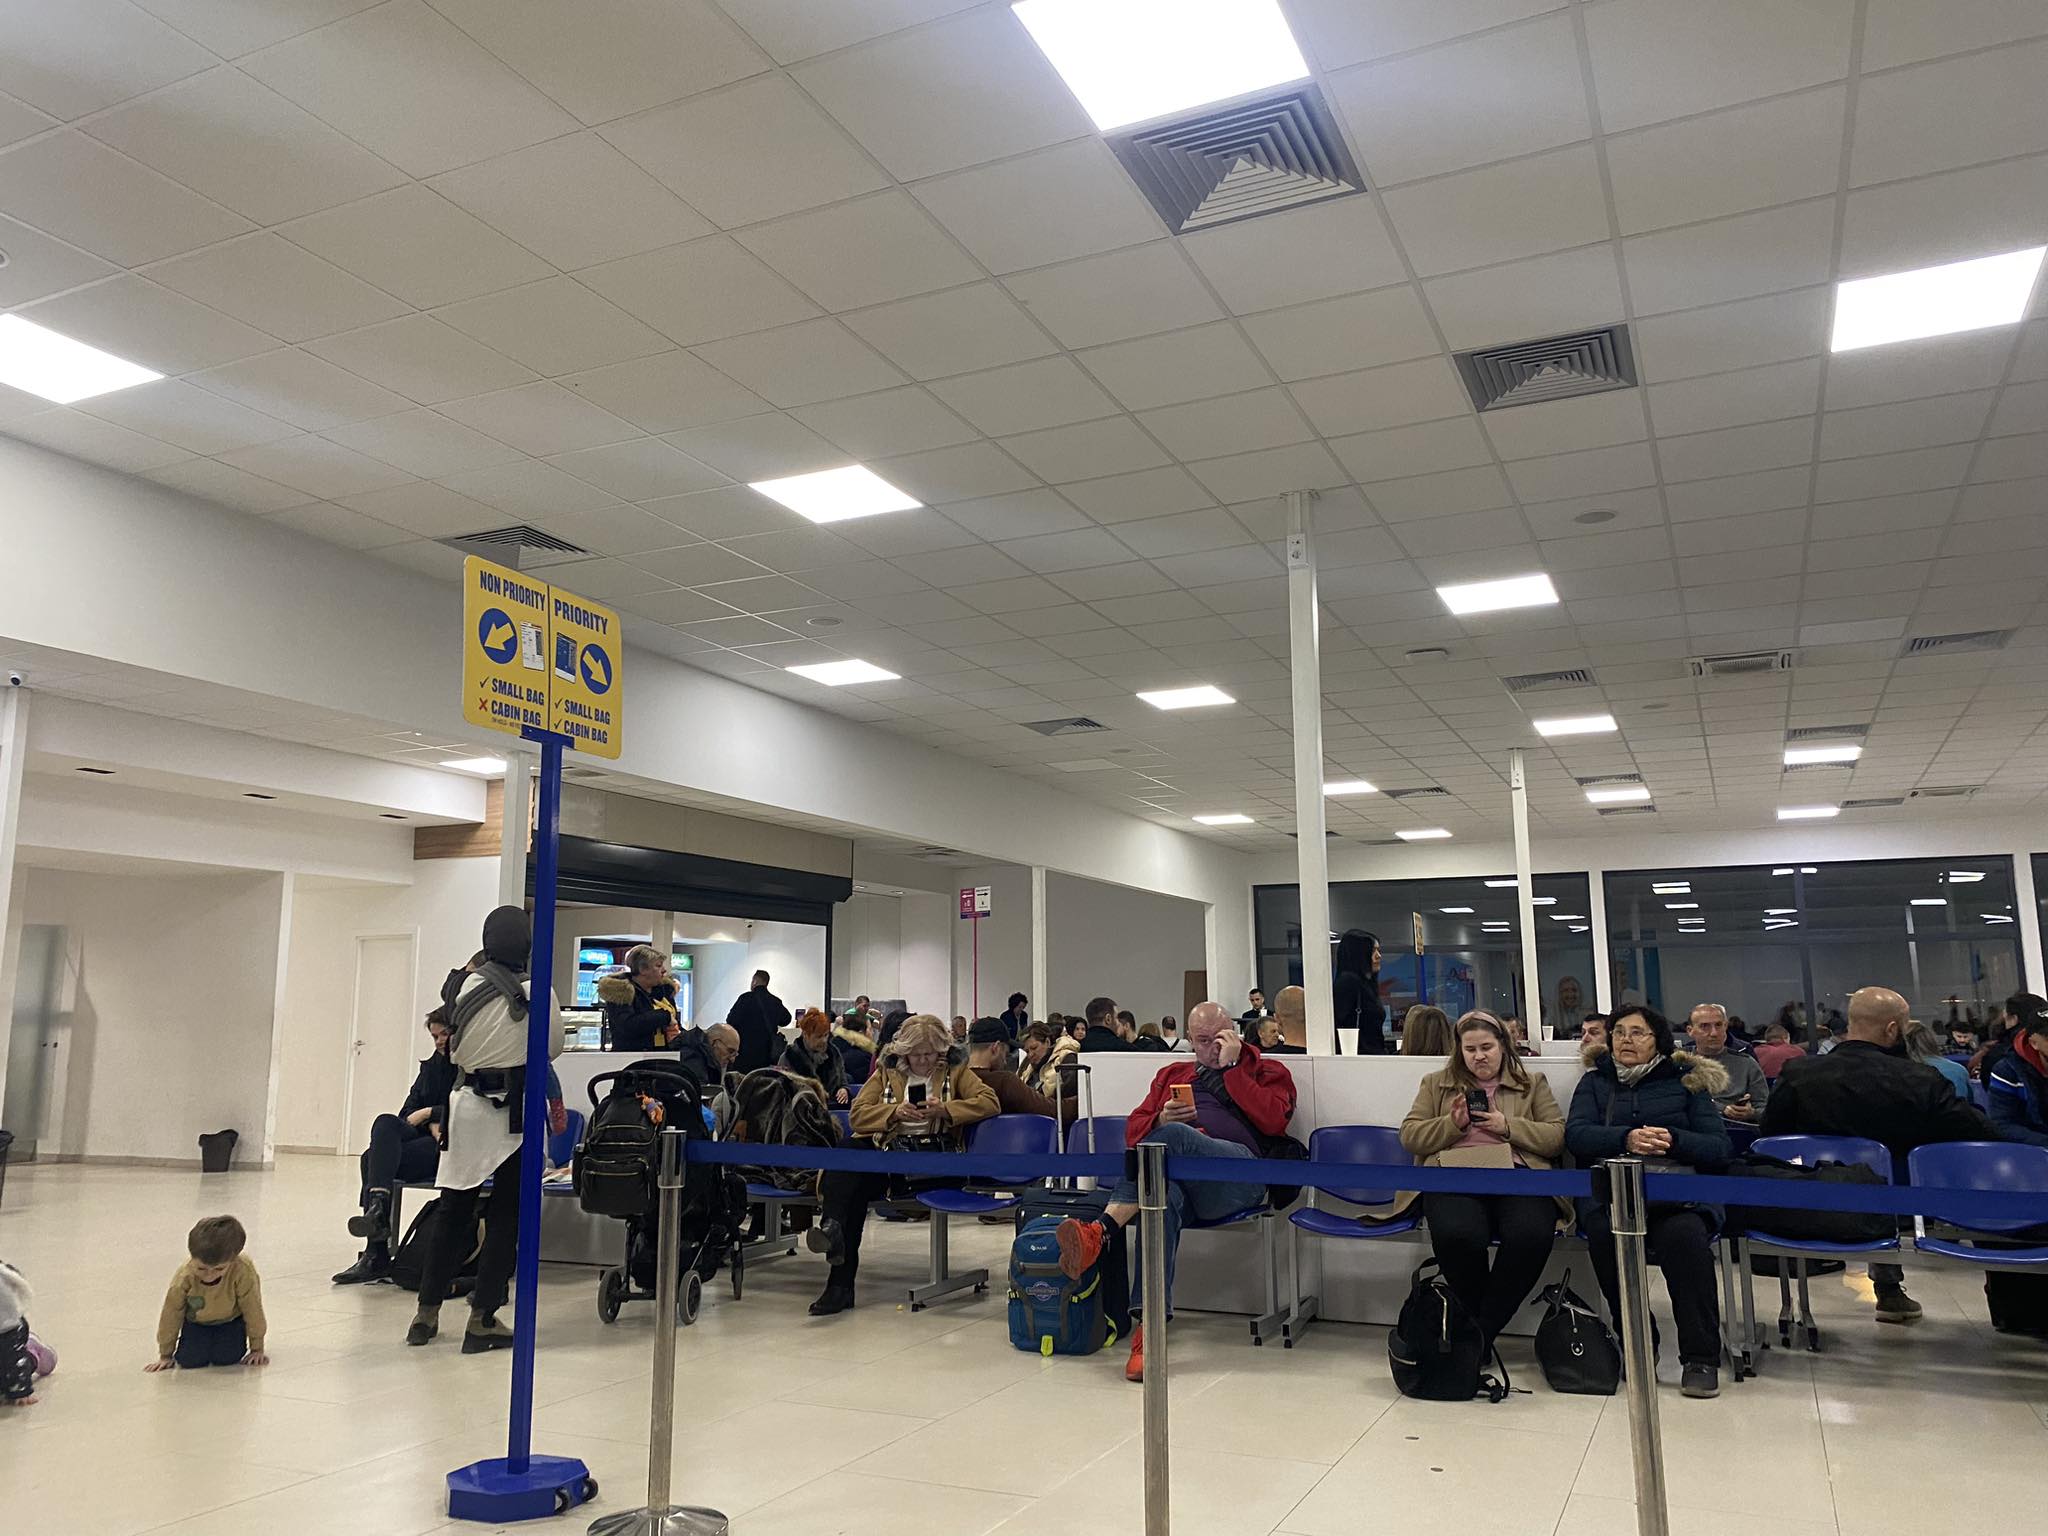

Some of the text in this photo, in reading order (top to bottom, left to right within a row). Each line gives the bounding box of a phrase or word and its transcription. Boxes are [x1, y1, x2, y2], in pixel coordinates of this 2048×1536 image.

[480, 571, 546, 611] NON PRIORITY
[554, 599, 608, 635] PRIORITY
[492, 678, 545, 706] SMALL BAG
[491, 700, 521, 721] CABIN
[523, 708, 541, 726] BAG
[564, 699, 610, 725] SMALL BAG
[564, 720, 608, 744] CABIN BAG
